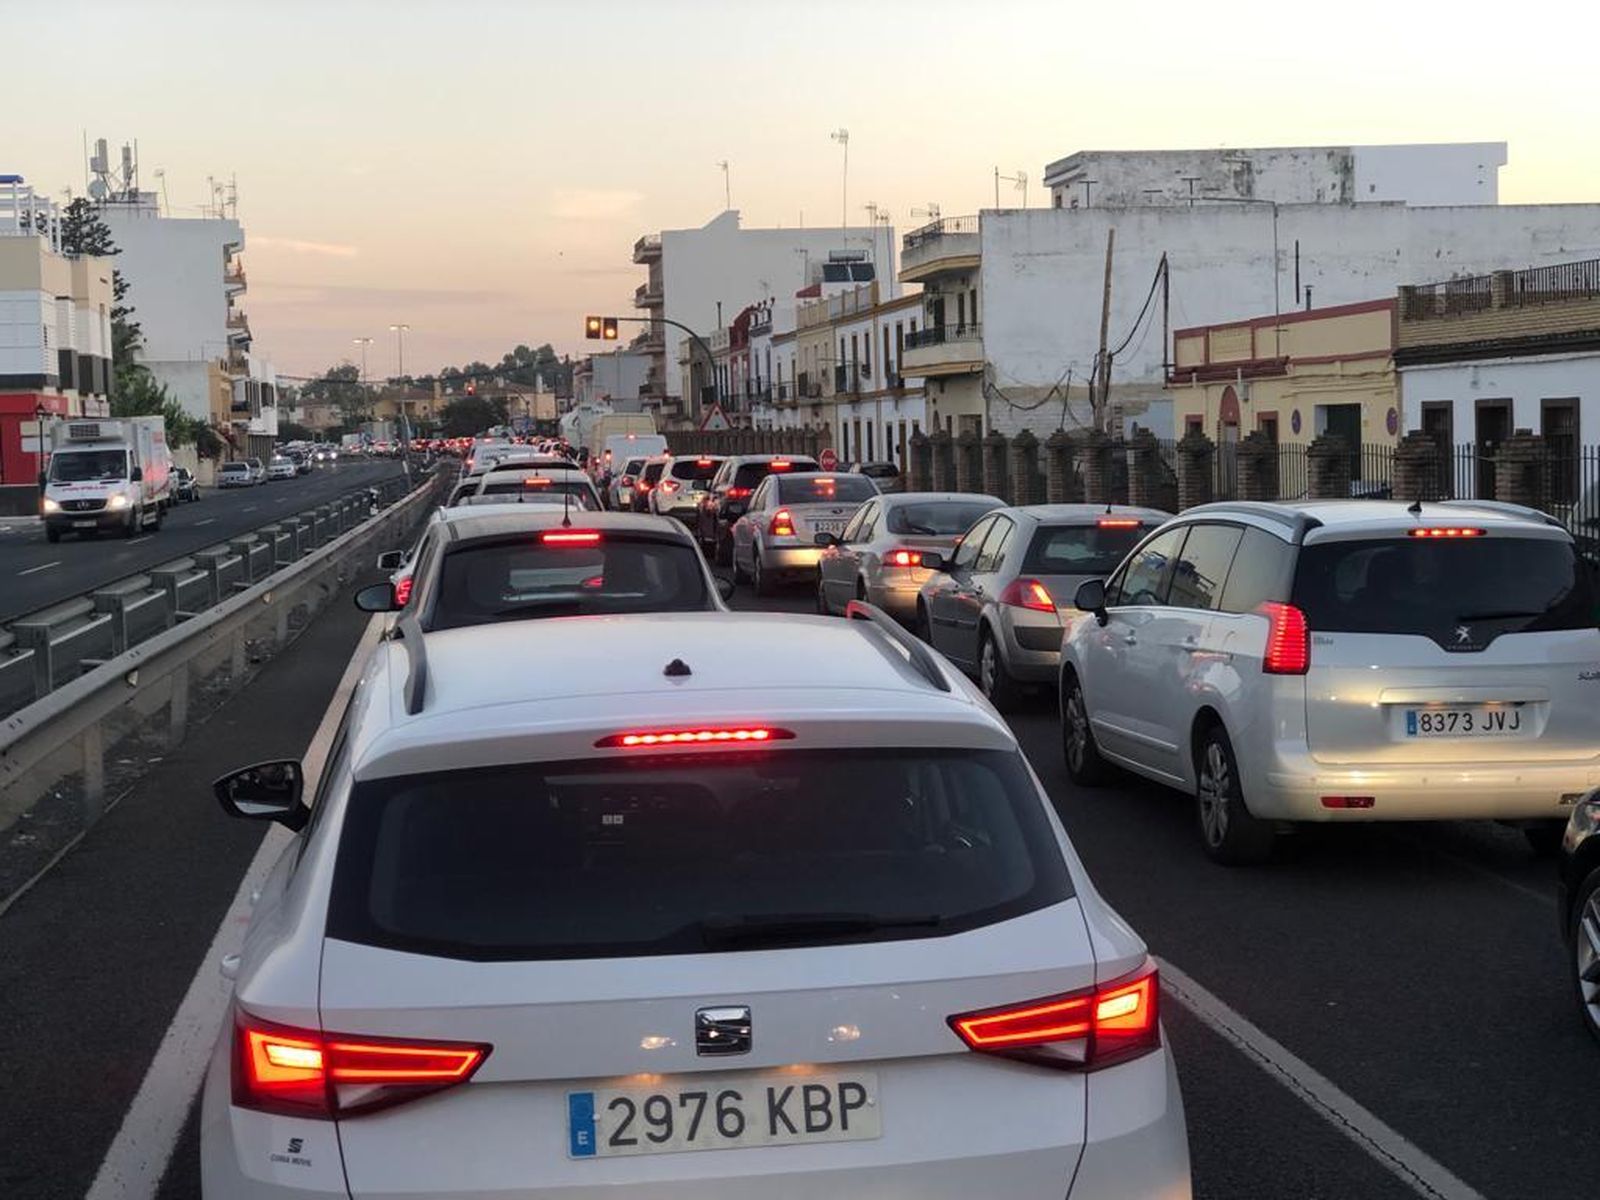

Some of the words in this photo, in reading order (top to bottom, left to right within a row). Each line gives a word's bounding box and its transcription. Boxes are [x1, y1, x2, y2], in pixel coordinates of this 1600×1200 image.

[1421, 712, 1473, 732] 8373
[1482, 711, 1520, 731] JVJ
[608, 1090, 745, 1147] 2976
[767, 1082, 867, 1136] KBP
[577, 1130, 589, 1146] E
